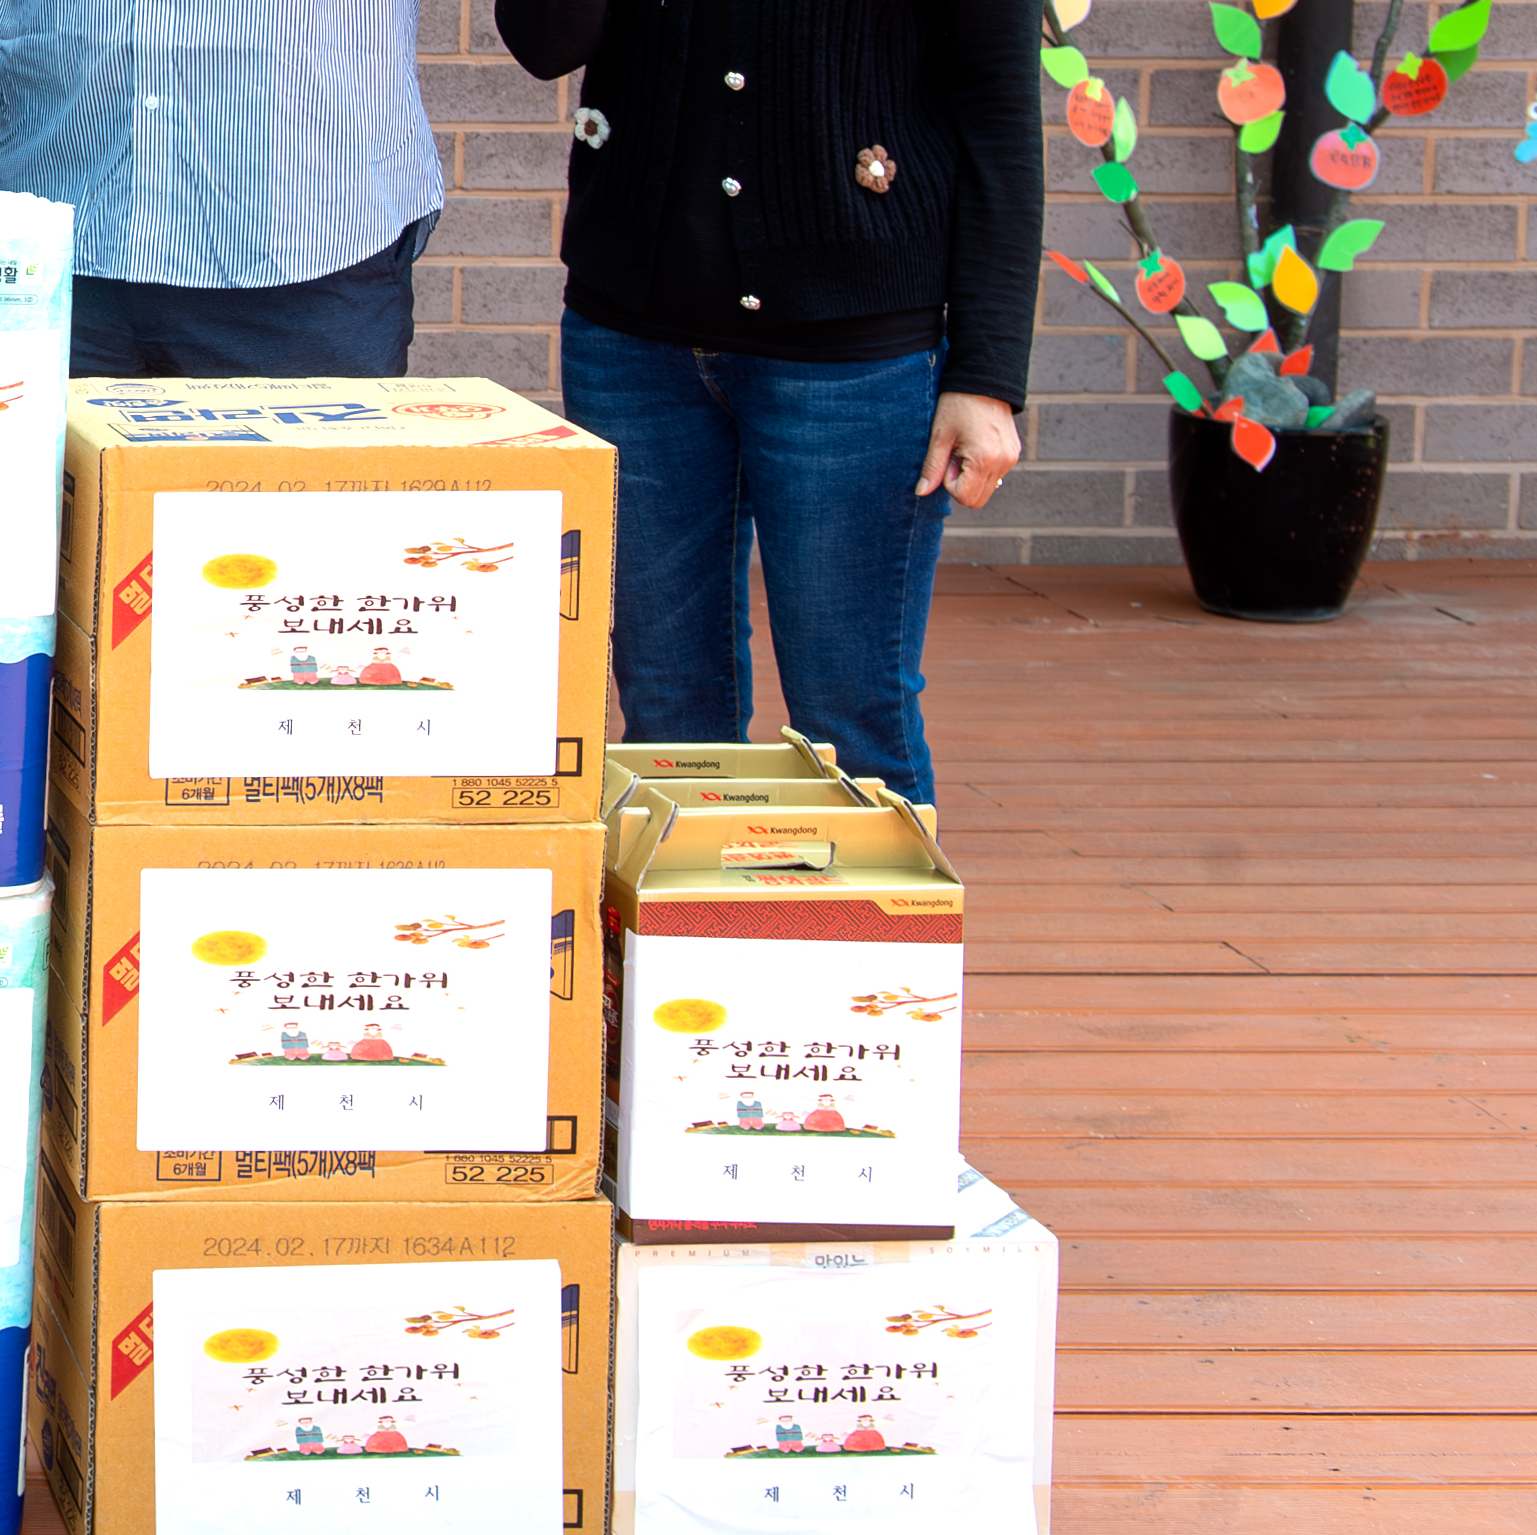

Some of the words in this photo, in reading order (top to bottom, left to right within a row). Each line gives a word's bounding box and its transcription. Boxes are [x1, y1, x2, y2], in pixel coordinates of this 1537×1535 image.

[240, 594, 344, 613] 풍성한
[356, 595, 457, 613] 한가위
[278, 617, 419, 635] 보내세요
[675, 759, 720, 769] Kwangdong
[453, 779, 457, 787] 1
[460, 779, 482, 787] 880
[486, 779, 511, 787] 1045
[515, 778, 548, 787] 52225
[181, 787, 215, 801] 6개월
[459, 791, 491, 806] 52
[502, 791, 551, 806] 225
[723, 793, 769, 802] Kwangdong
[770, 825, 817, 835] Kwangdong
[910, 898, 953, 907] Kwangdong
[229, 971, 335, 989] 풍성한
[347, 971, 448, 989] 한가위
[268, 993, 410, 1011] 보내세요
[690, 1039, 790, 1058] 풍성한
[804, 1042, 901, 1061] 한가위
[725, 1063, 862, 1082] 보내세요
[173, 1162, 207, 1176] 6개월
[451, 1166, 485, 1182] 52
[496, 1166, 545, 1182] 225
[242, 1365, 347, 1385] 풍성한
[359, 1362, 460, 1382] 한가위
[725, 1364, 828, 1383] 풍성한
[841, 1362, 938, 1381] 한가위
[282, 1386, 423, 1406] 보내세요
[763, 1385, 901, 1404] 보내세요
